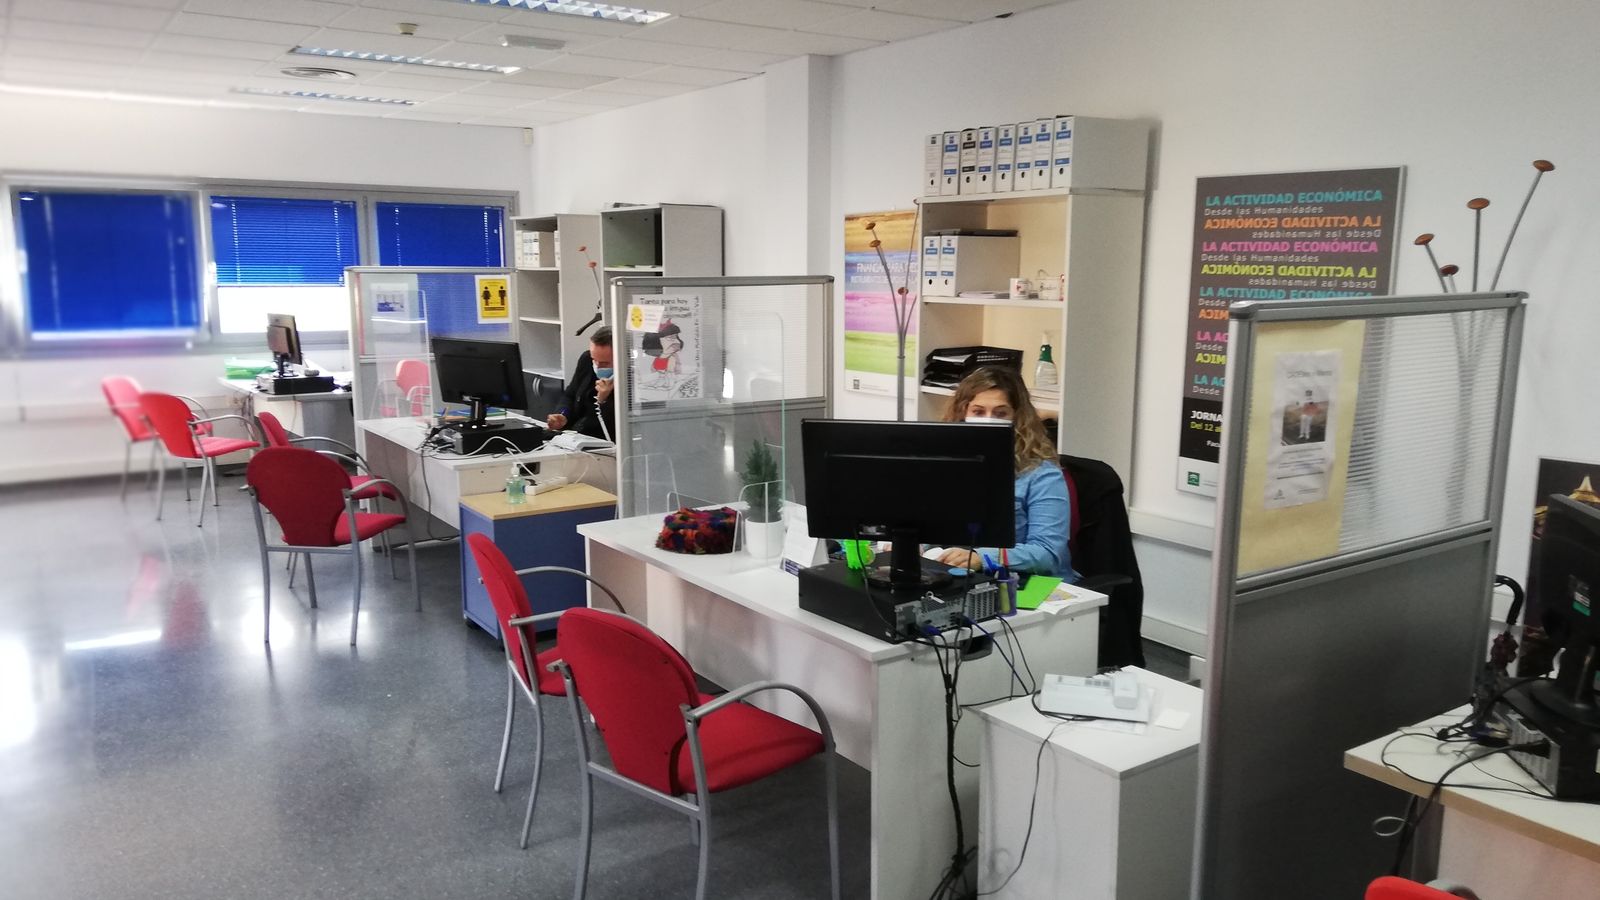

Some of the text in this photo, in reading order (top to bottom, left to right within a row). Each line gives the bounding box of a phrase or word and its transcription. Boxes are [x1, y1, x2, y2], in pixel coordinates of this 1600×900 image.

[1206, 187, 1383, 206] LA ACTIVIDAD ECONÓMICA
[1204, 205, 1324, 216] Desde las Humanidades
[1203, 238, 1378, 253] LA ACTIVIDAD ECONÓMICA
[1201, 253, 1320, 263] Desde las Humanidades
[1200, 287, 1214, 297] LA
[1217, 288, 1287, 300] ACTIVIDAD
[1198, 298, 1227, 307] Desde
[1196, 331, 1211, 341] LA
[1195, 343, 1223, 352] Desde
[1194, 375, 1208, 385] LA
[1192, 386, 1220, 396] Desde
[1190, 410, 1223, 422] JORNA
[1190, 421, 1204, 430] Del
[1204, 423, 1214, 432] 12
